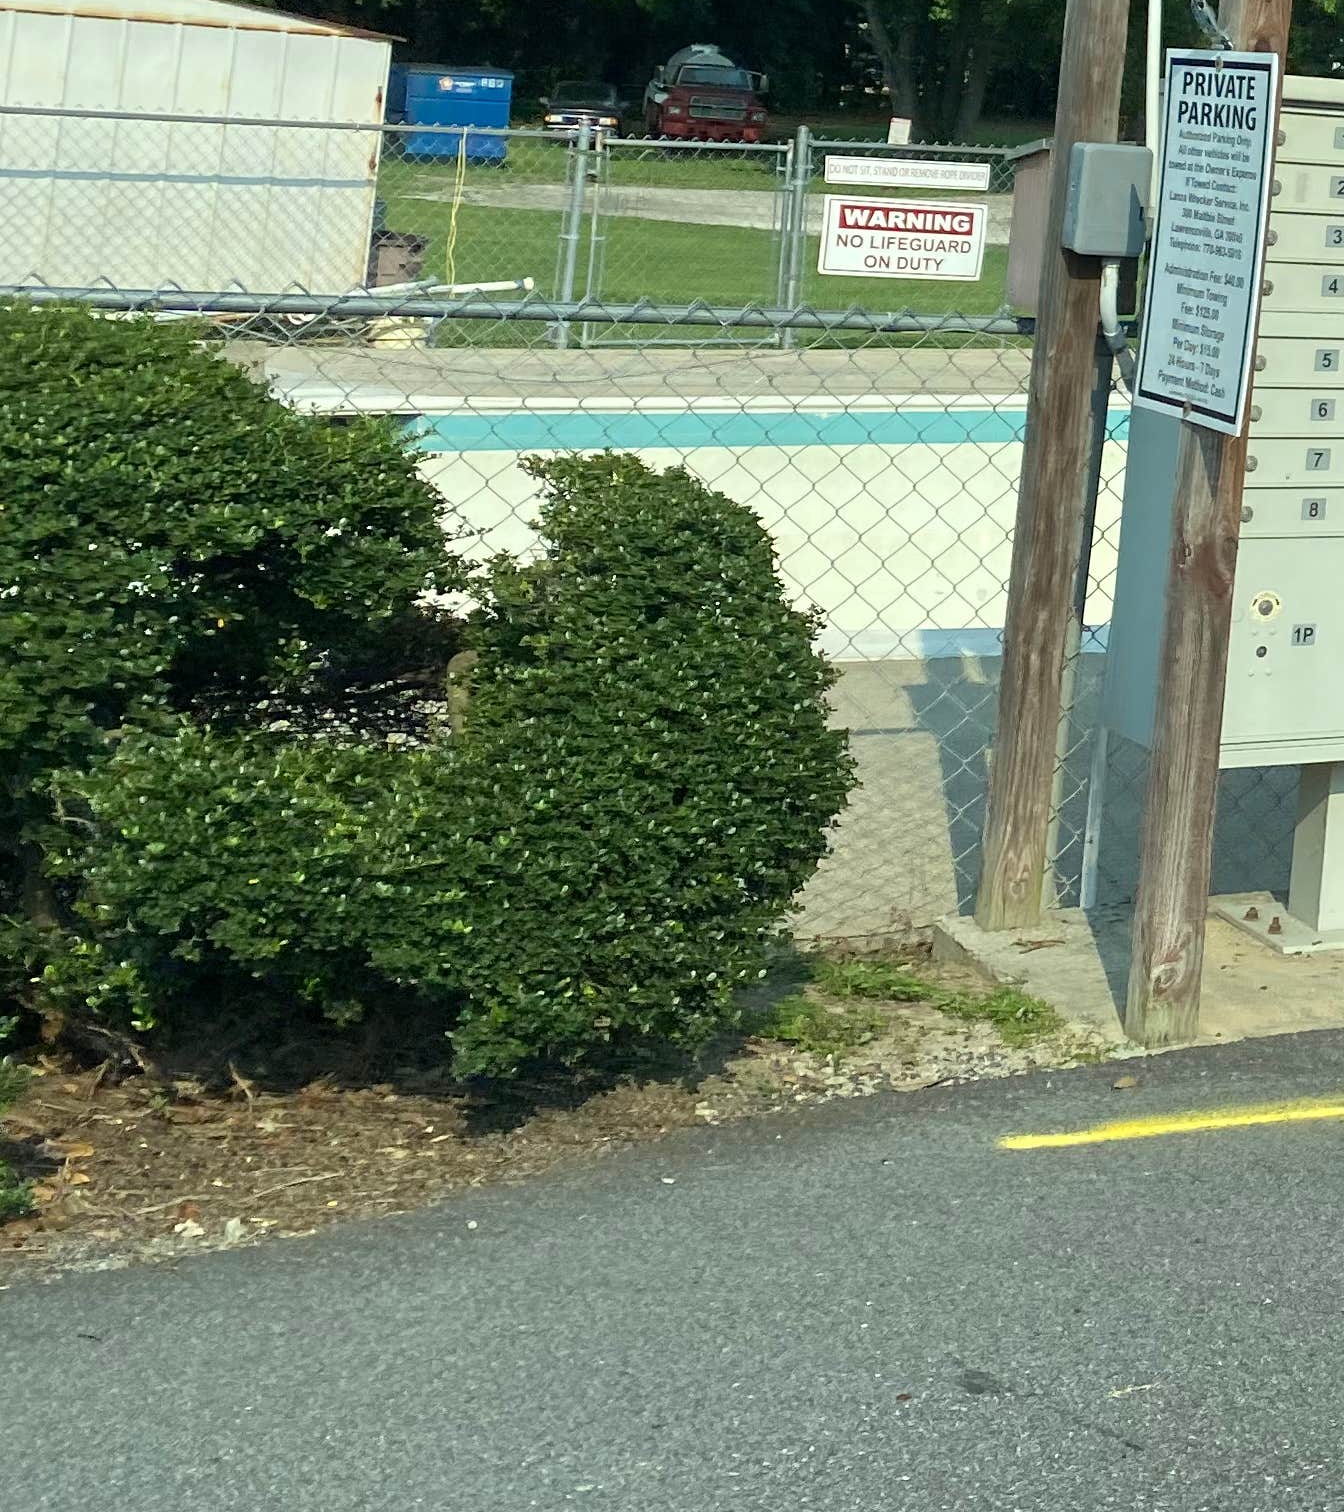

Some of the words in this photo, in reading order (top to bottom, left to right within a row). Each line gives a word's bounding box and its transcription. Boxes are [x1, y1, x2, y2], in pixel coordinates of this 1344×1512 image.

[1183, 71, 1256, 100] PRIVATE
[1178, 100, 1256, 131] PARKING
[1212, 131, 1235, 147] Parking
[1205, 148, 1230, 160] vehicles
[830, 164, 840, 174] DO
[843, 164, 858, 175] NOT
[873, 166, 897, 177] STAND
[843, 208, 970, 232] WARNING
[836, 234, 863, 248] NO
[870, 236, 971, 254] LIFEGUARD
[1332, 230, 1343, 244] 3
[864, 255, 890, 269] ON
[897, 257, 944, 271] DUTY
[1328, 279, 1339, 293] 4
[1322, 353, 1332, 367] 5
[1176, 356, 1195, 371] Hours
[1205, 362, 1220, 380] Days
[1210, 383, 1226, 399] Cash
[1318, 403, 1328, 417] 6
[1313, 453, 1324, 467] 7
[1308, 503, 1319, 517] 8
[1294, 628, 1314, 642] 1P
